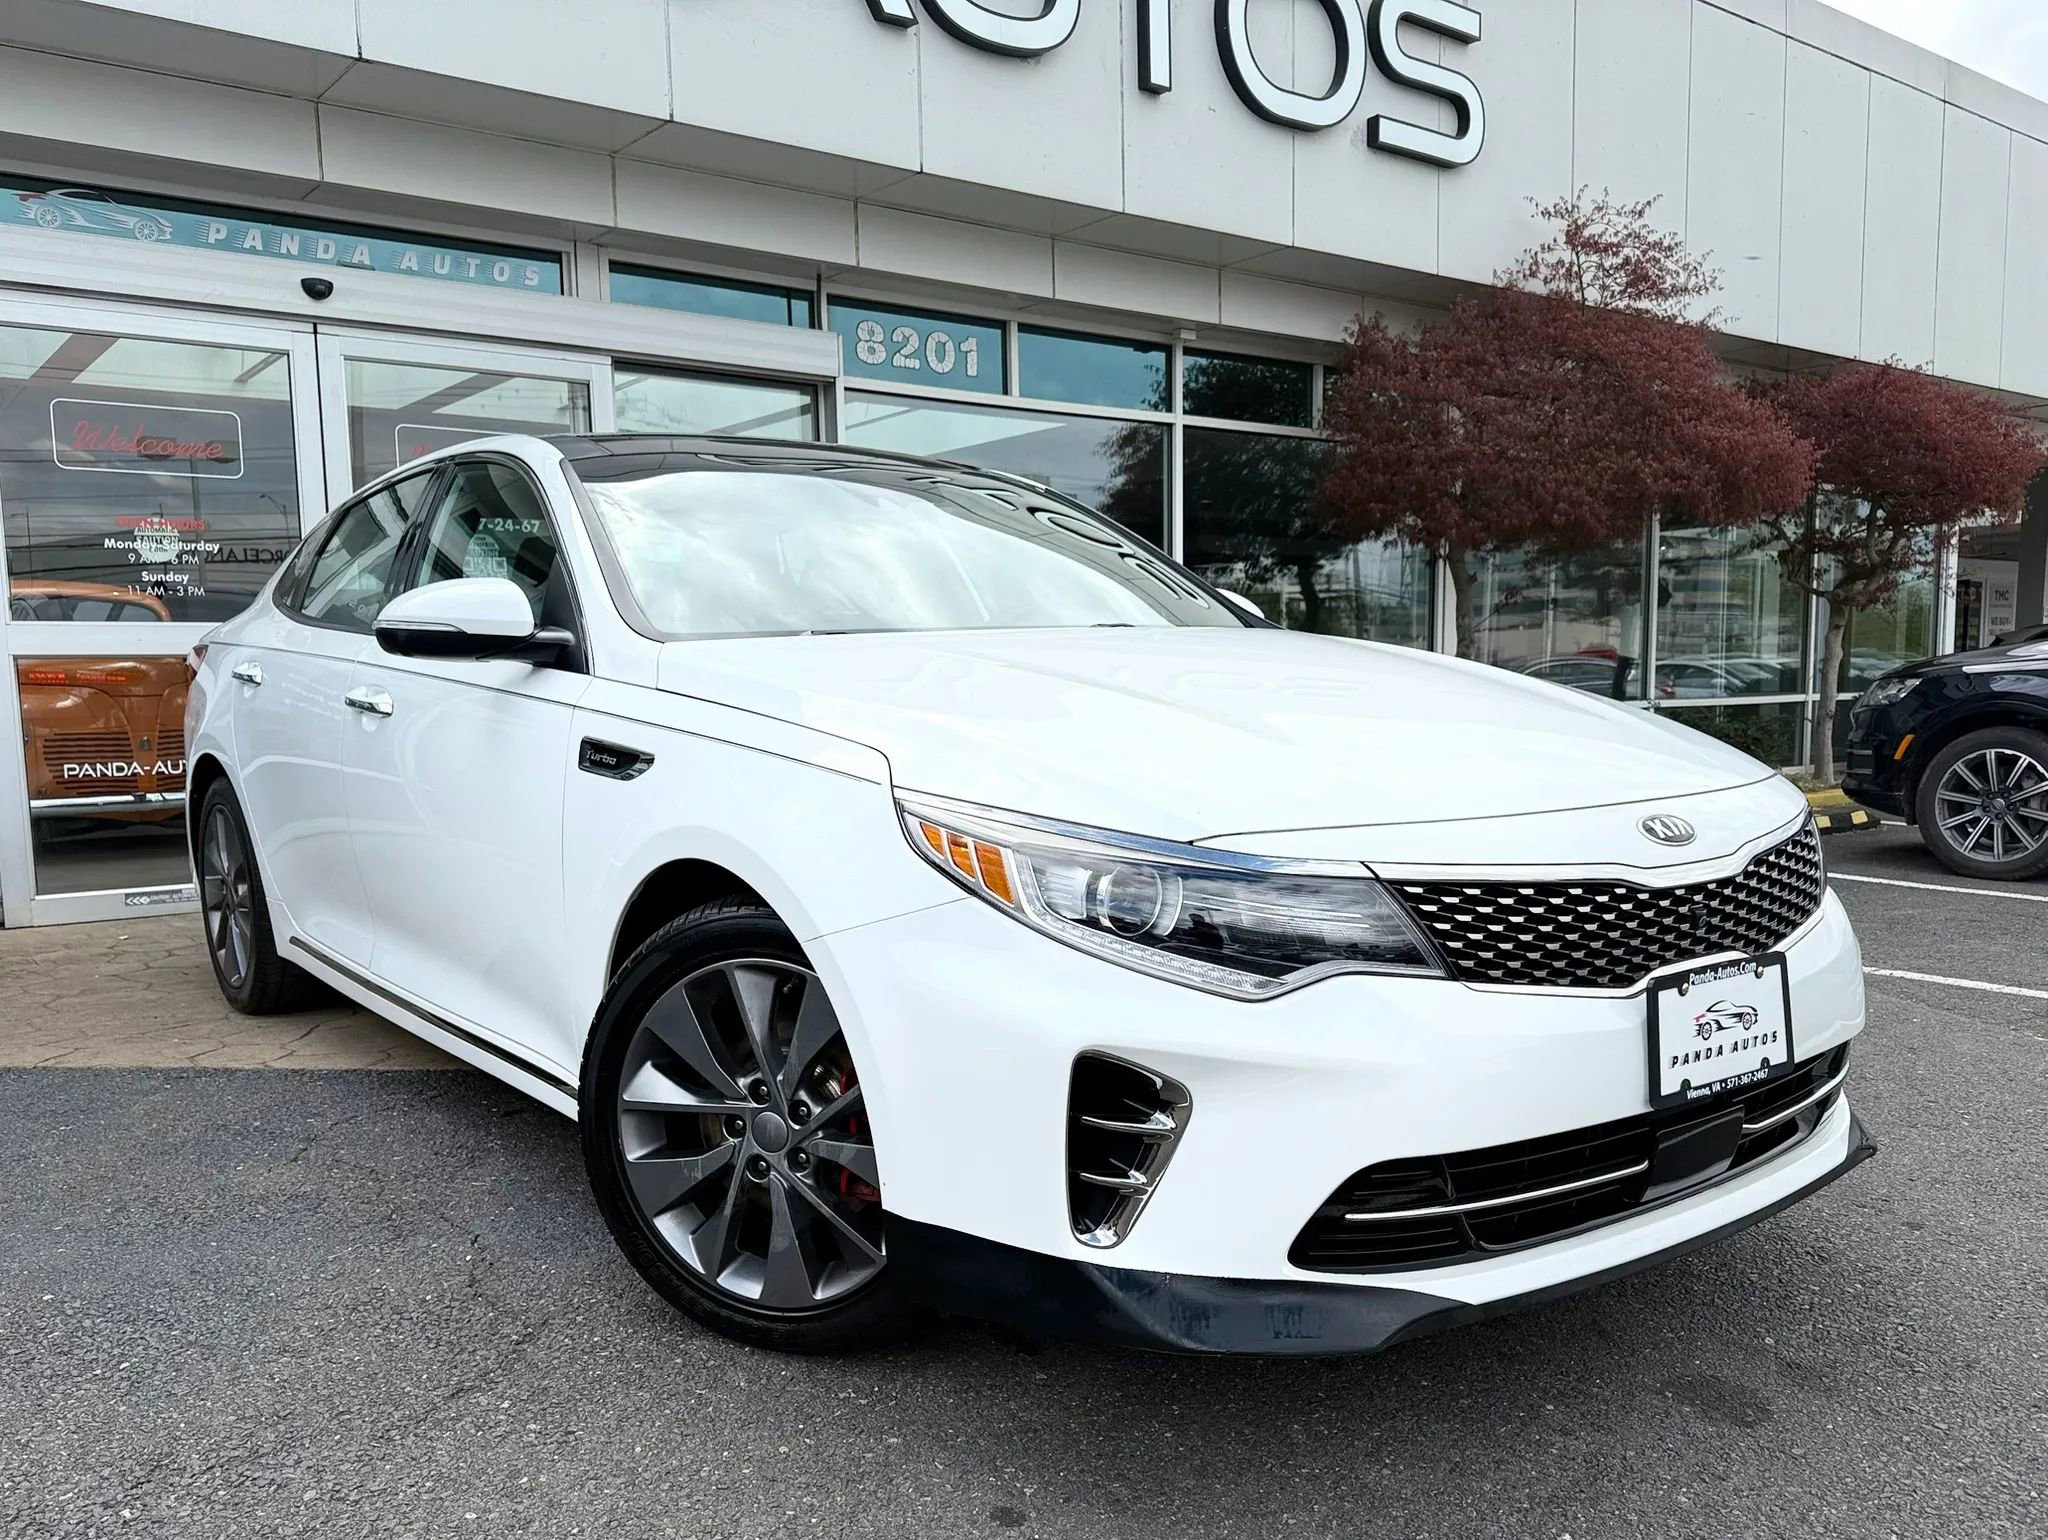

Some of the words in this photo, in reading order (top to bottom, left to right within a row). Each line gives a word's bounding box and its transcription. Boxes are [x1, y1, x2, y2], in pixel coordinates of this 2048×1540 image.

[207, 222, 371, 265] PANDA
[399, 250, 541, 286] AUTOS
[856, 320, 978, 377] 8201
[73, 421, 224, 459] Welcome
[478, 517, 540, 534] 7-24-67
[128, 553, 136, 564] 9
[171, 556, 178, 565] 6
[182, 554, 200, 565] PM
[141, 571, 189, 585] Sunday
[127, 585, 141, 596] 11
[145, 586, 165, 596] AM
[176, 586, 184, 597] 3
[188, 586, 205, 597] PM
[584, 749, 618, 765] Turbo
[63, 760, 186, 779] PANDA-AU
[1689, 961, 1757, 986] Panda-Autos.Com
[1670, 1044, 1724, 1069] PANDA
[1732, 1030, 1778, 1053] AUTOS
[1686, 1087, 1712, 1100] Vienna,
[1712, 1082, 1721, 1092] VA
